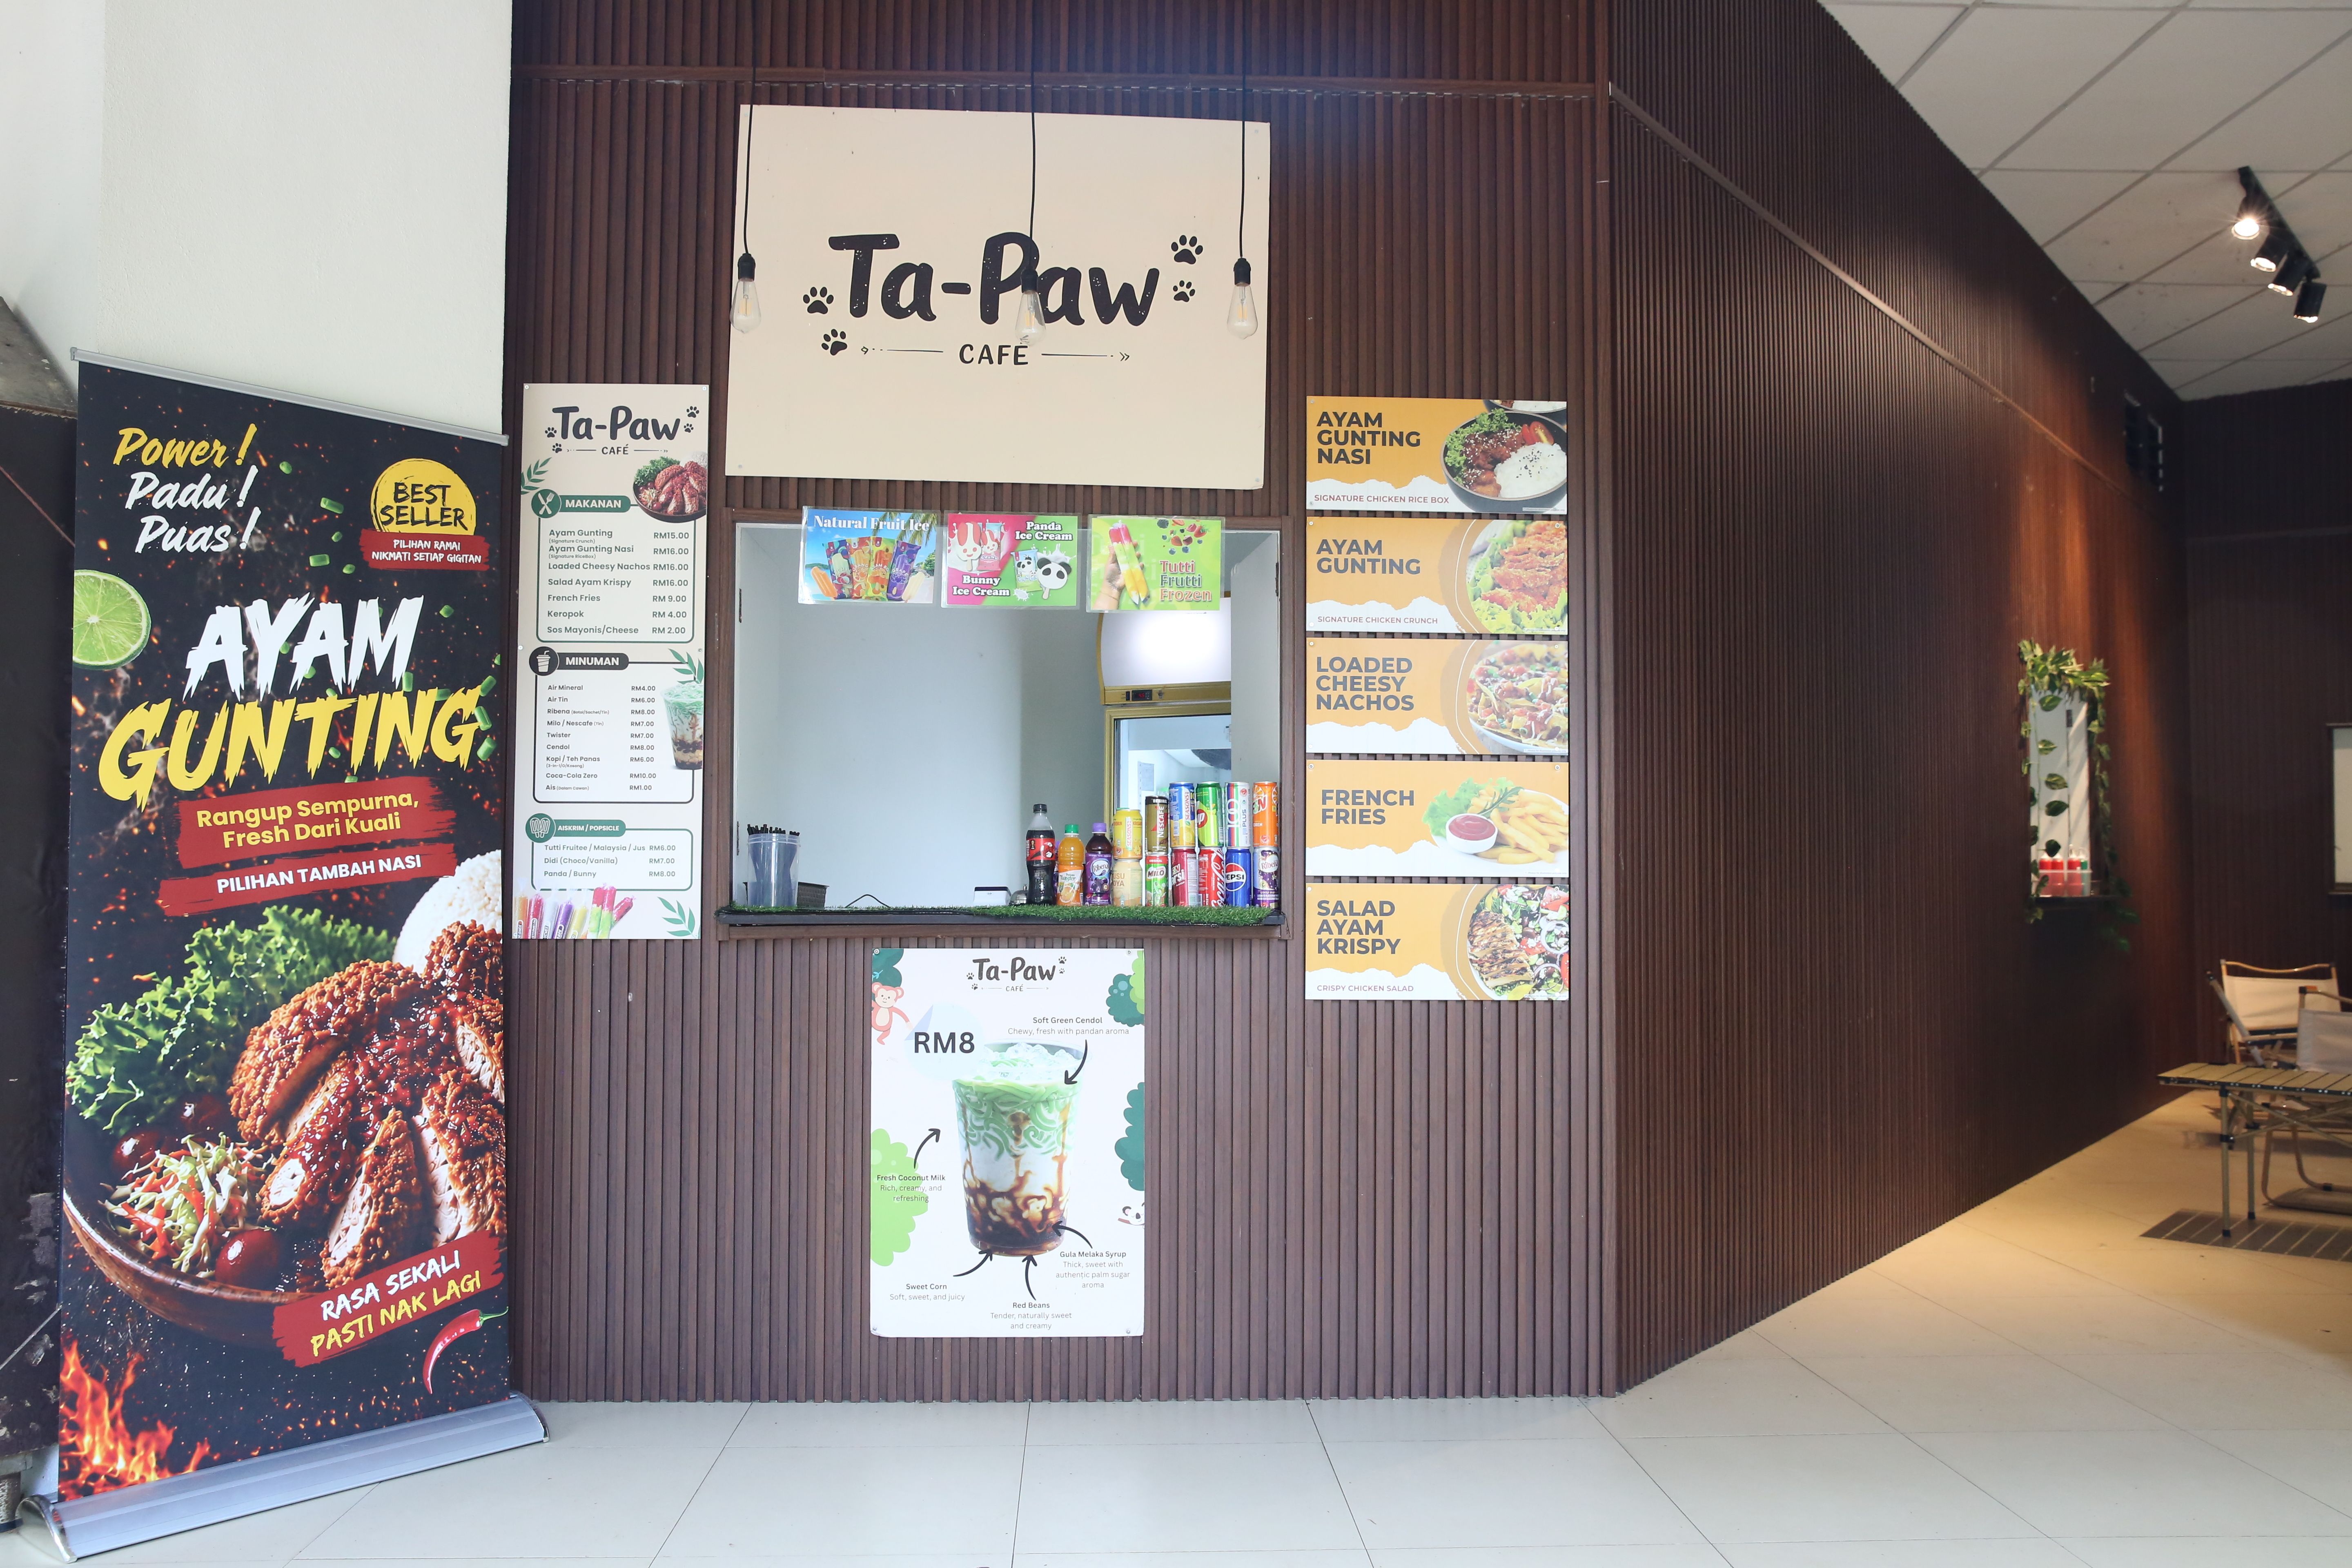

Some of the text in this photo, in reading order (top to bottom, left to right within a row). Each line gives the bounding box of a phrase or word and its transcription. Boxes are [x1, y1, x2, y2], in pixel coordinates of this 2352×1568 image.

[828, 232, 1159, 325] Ta-Paw
[552, 405, 681, 440] Ta-Paw
[1316, 412, 1382, 428] AYAM
[1317, 430, 1420, 447] GUNTING
[602, 444, 628, 454] CAFÉ
[1318, 448, 1370, 464] NASI
[394, 482, 451, 506] BEST
[380, 505, 468, 530] SELLER
[814, 515, 929, 531] Natural Fruit Ice
[549, 529, 612, 538] Ayam Gunting
[1026, 522, 1061, 531] Panda
[1016, 531, 1073, 541] Ice Cream
[393, 539, 460, 550] PILIHAN RAMAI
[549, 546, 575, 554] Ayam
[577, 545, 612, 555] Gunting
[1316, 539, 1382, 555] AYAM
[372, 551, 481, 564] NIKMATI SETIAP GIGITAN
[583, 563, 615, 572] Cheesy
[1160, 560, 1195, 573] Tutti
[1317, 558, 1420, 575] GUNTING
[575, 579, 601, 587] Ayam
[604, 579, 631, 588] Krispy
[962, 575, 1000, 586] Bunny
[1160, 574, 1202, 587] Frutti
[953, 587, 1010, 596] Ice Cream
[1160, 589, 1212, 601] Frozen
[548, 610, 584, 619] Keropok
[565, 625, 638, 635] Mayonis/Cheese
[183, 592, 424, 702] AYAM
[1317, 657, 1412, 673] LOADED
[1316, 675, 1406, 692] CHEESY
[1317, 694, 1414, 710] NACHOS
[97, 685, 486, 813] GUNTING
[1322, 790, 1414, 806] FRENCH
[197, 793, 419, 828] Rangup Sempurna,
[1322, 808, 1385, 824] FRIES
[223, 812, 401, 848] Fresh Dari Kuali
[560, 857, 617, 865] (Choco/Vanilla)
[1093, 863, 1109, 871] Ribena
[217, 855, 421, 893] PILIHAN TAMBAH NASI
[1148, 869, 1164, 878] MILO
[1317, 900, 1395, 916] SALAD
[1316, 920, 1383, 935] AYAM
[1318, 938, 1401, 954] KRISPY
[973, 957, 1056, 981] Ta-Paw
[914, 1032, 975, 1054] RM8
[321, 1250, 460, 1321] RASA SEKALI
[310, 1270, 481, 1357] PASTI NAK LAGI
